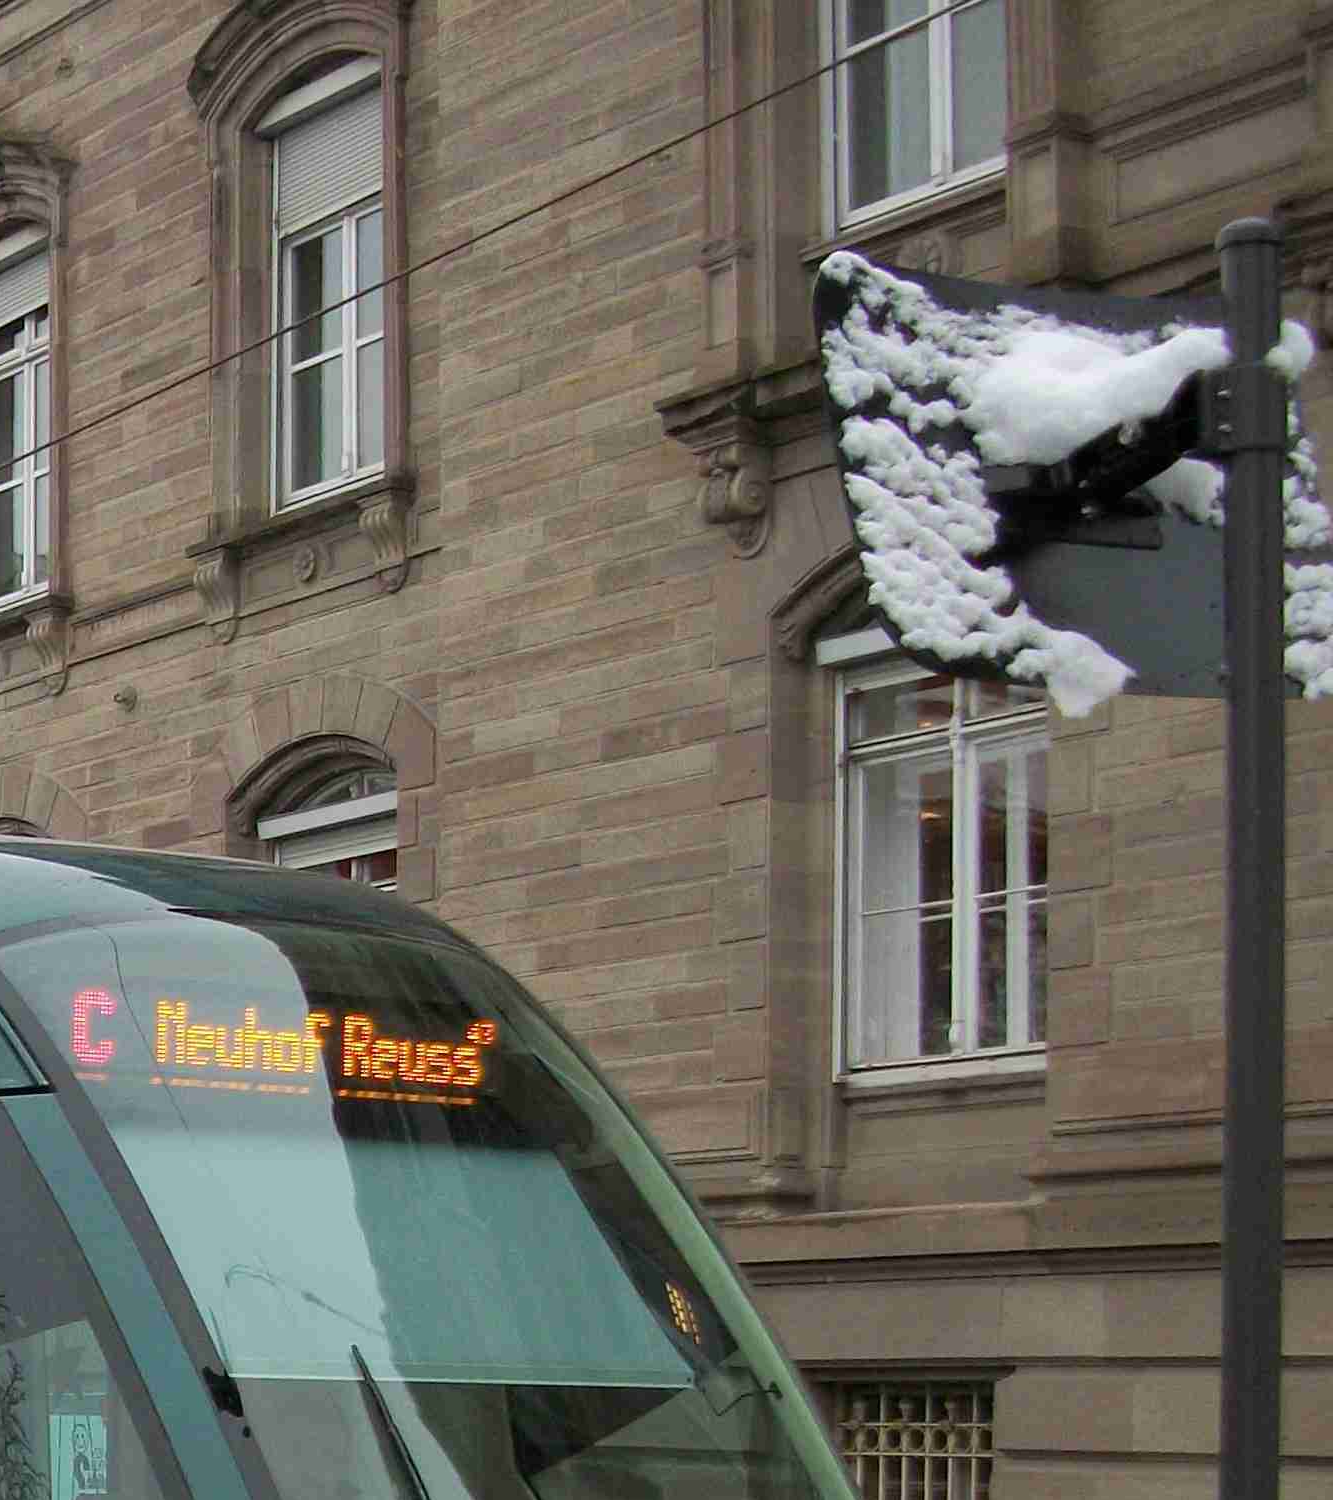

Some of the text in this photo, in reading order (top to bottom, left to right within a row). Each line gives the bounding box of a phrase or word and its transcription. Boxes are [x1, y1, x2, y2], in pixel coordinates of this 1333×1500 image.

[72, 991, 480, 1087] C Neuhof Reuss
